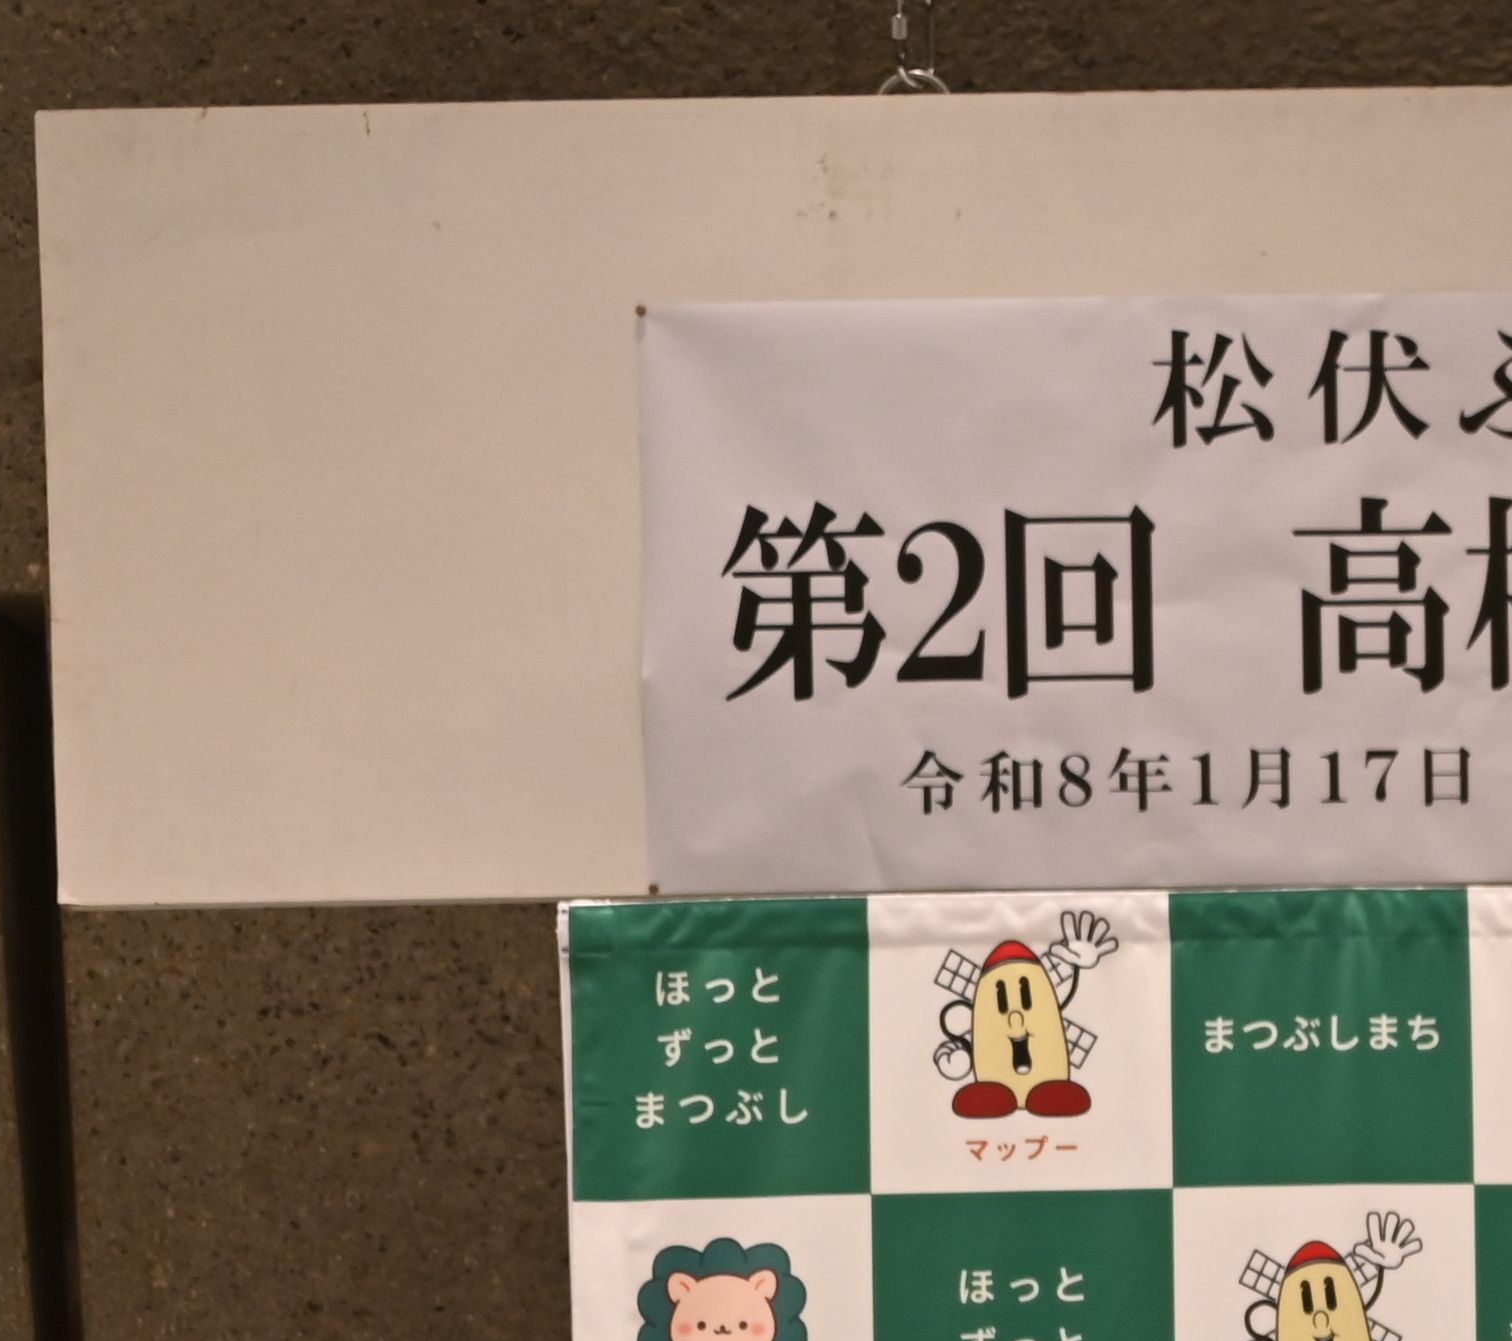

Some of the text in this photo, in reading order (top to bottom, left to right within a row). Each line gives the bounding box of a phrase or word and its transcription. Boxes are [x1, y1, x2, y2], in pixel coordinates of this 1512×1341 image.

[721, 500, 1158, 702] 第2回
[900, 746, 1476, 817] 令和8年1月17日
[655, 967, 781, 1006] ほっと
[656, 1027, 780, 1068] ずっと
[1203, 1013, 1441, 1054] まつぶしまち
[634, 1087, 809, 1129] まつぶし
[964, 1134, 1079, 1163] マップー
[958, 1266, 1086, 1304] ほっと
